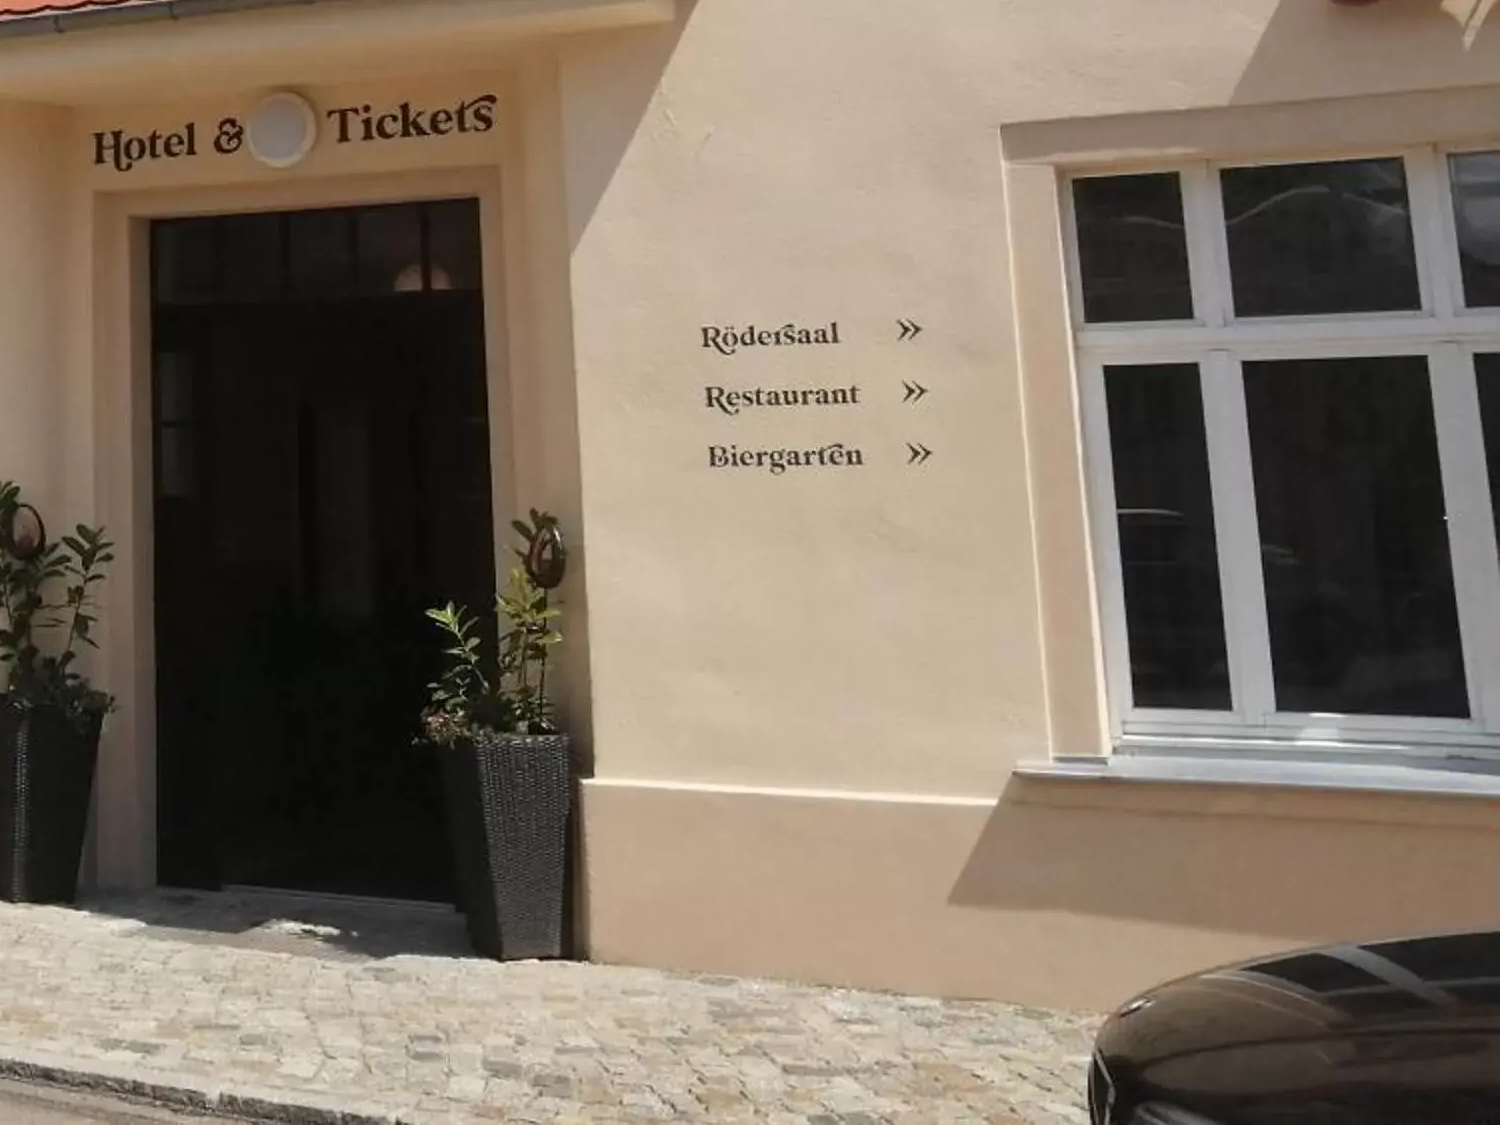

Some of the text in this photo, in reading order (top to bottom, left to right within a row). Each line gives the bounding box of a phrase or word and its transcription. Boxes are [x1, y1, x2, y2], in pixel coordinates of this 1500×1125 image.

[92, 94, 497, 172] Hotel & Tickets
[701, 322, 843, 355] Rödersaal
[705, 385, 861, 415] Restaurant
[708, 443, 864, 475] Biergarten
